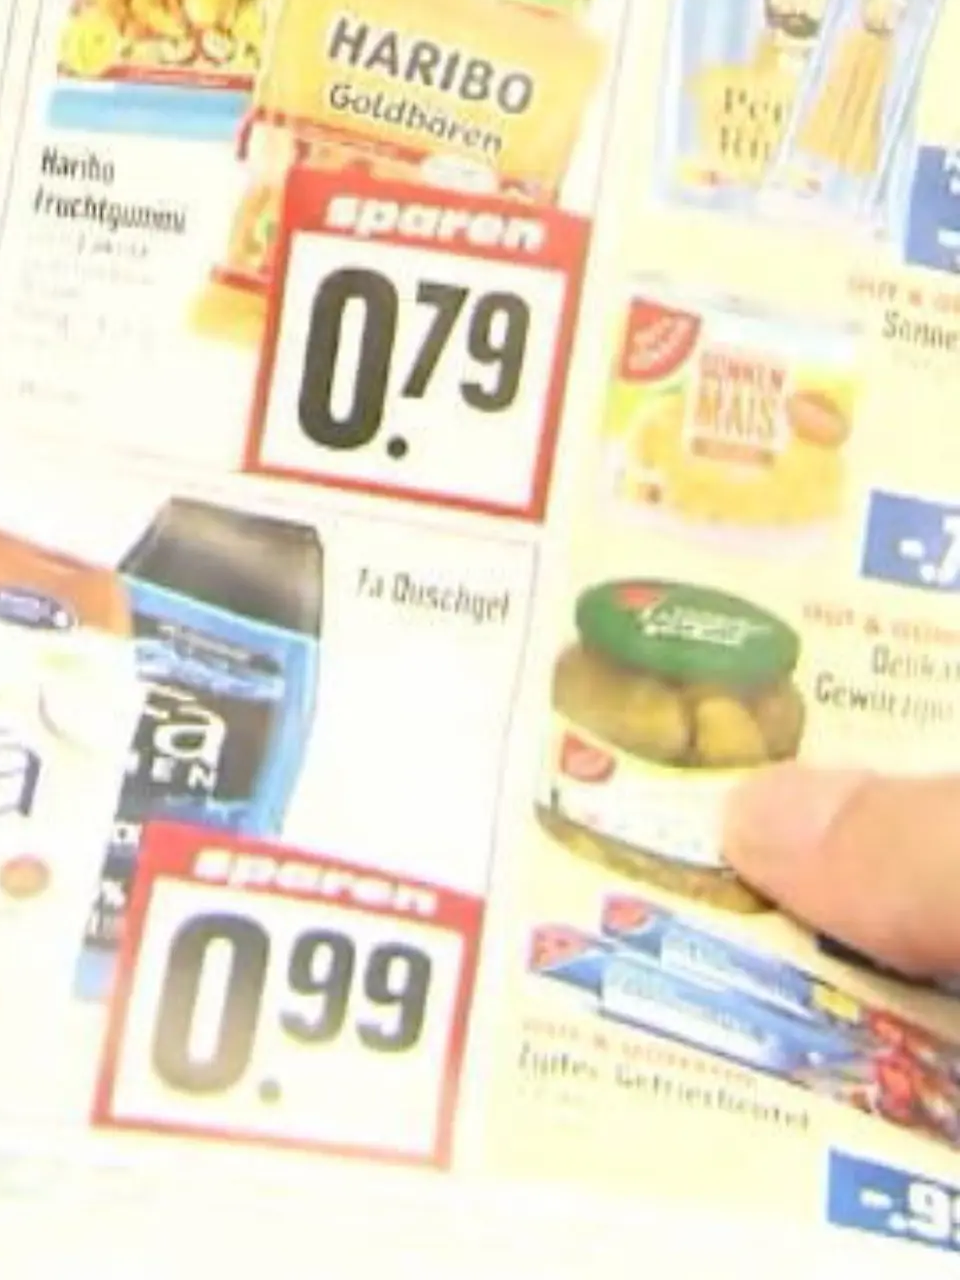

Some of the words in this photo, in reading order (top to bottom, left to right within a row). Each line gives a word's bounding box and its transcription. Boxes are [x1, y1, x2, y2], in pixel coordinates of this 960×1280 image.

[326, 15, 536, 116] HARIBO
[326, 81, 505, 156] Goldbären
[326, 194, 546, 252] sparen
[296, 265, 532, 462] 0.79
[193, 848, 437, 917] sparen
[150, 908, 434, 1105] 0.99
